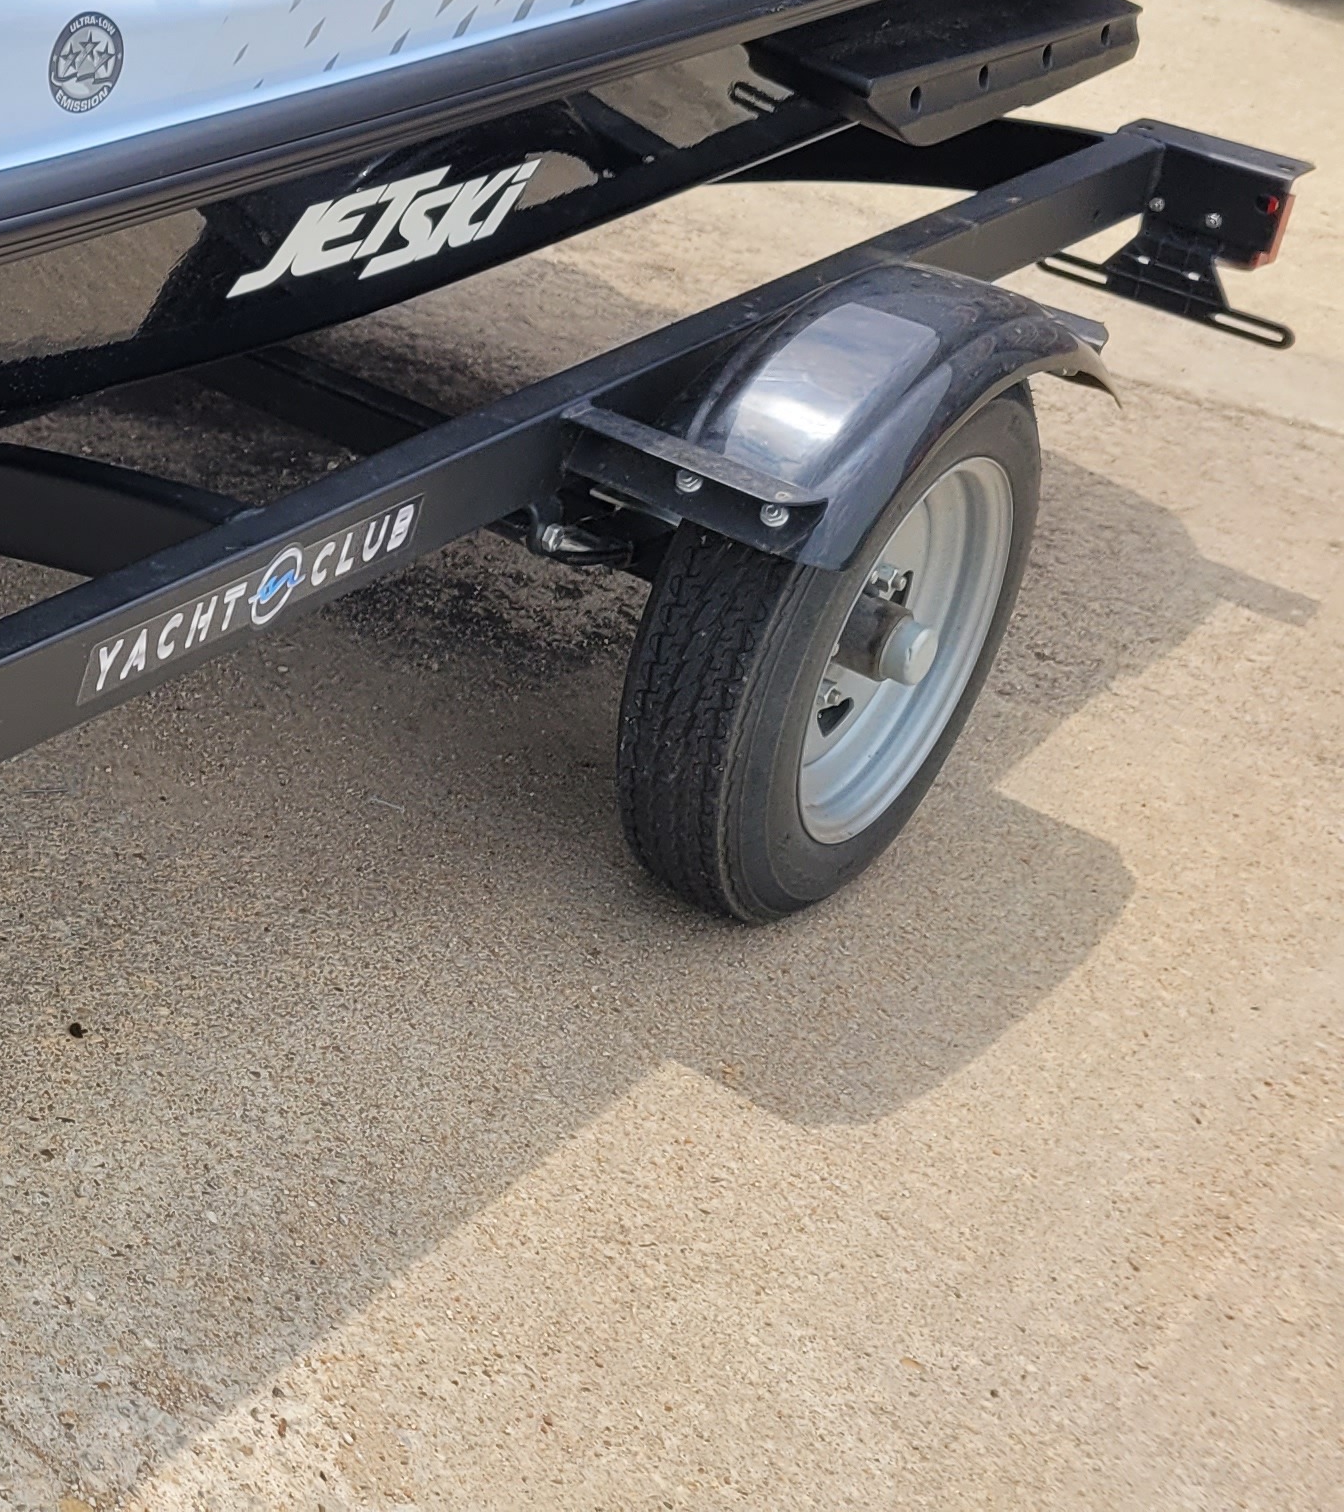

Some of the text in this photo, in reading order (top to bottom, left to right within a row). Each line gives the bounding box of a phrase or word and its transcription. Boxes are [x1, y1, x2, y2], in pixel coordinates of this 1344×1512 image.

[69, 15, 116, 36] ULTRA-LOW
[55, 86, 109, 112] EMISSION
[96, 503, 415, 692] YACHT CLUB
